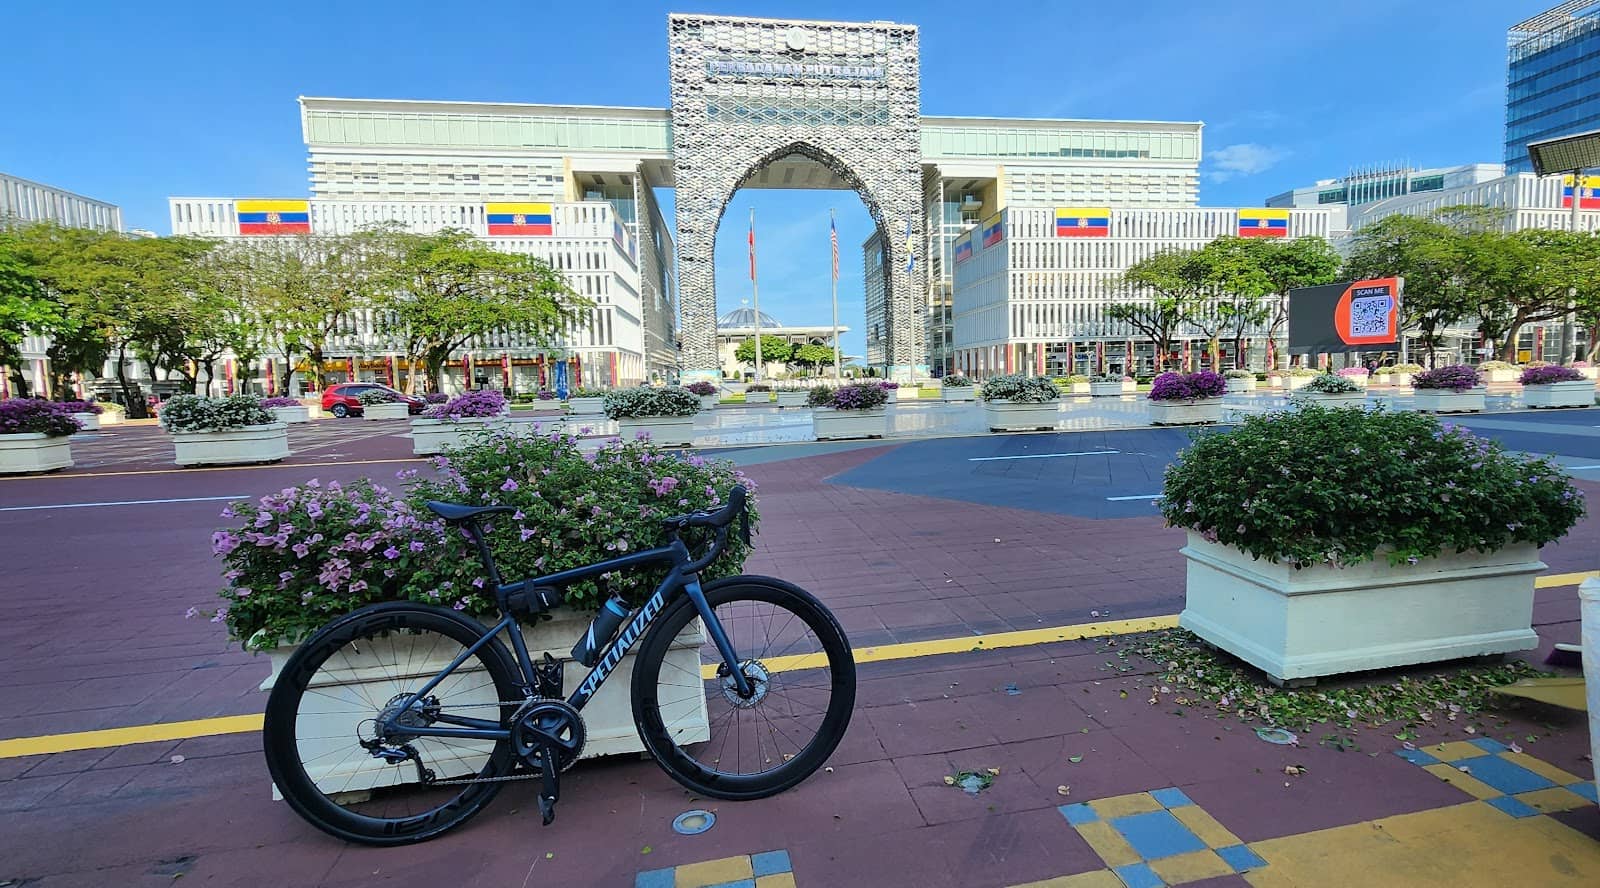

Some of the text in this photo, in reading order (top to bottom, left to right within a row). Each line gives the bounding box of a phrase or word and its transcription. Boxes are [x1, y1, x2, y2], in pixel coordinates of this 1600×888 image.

[1357, 287, 1385, 297] SCAN ME
[580, 591, 664, 699] SPECIALIZED
